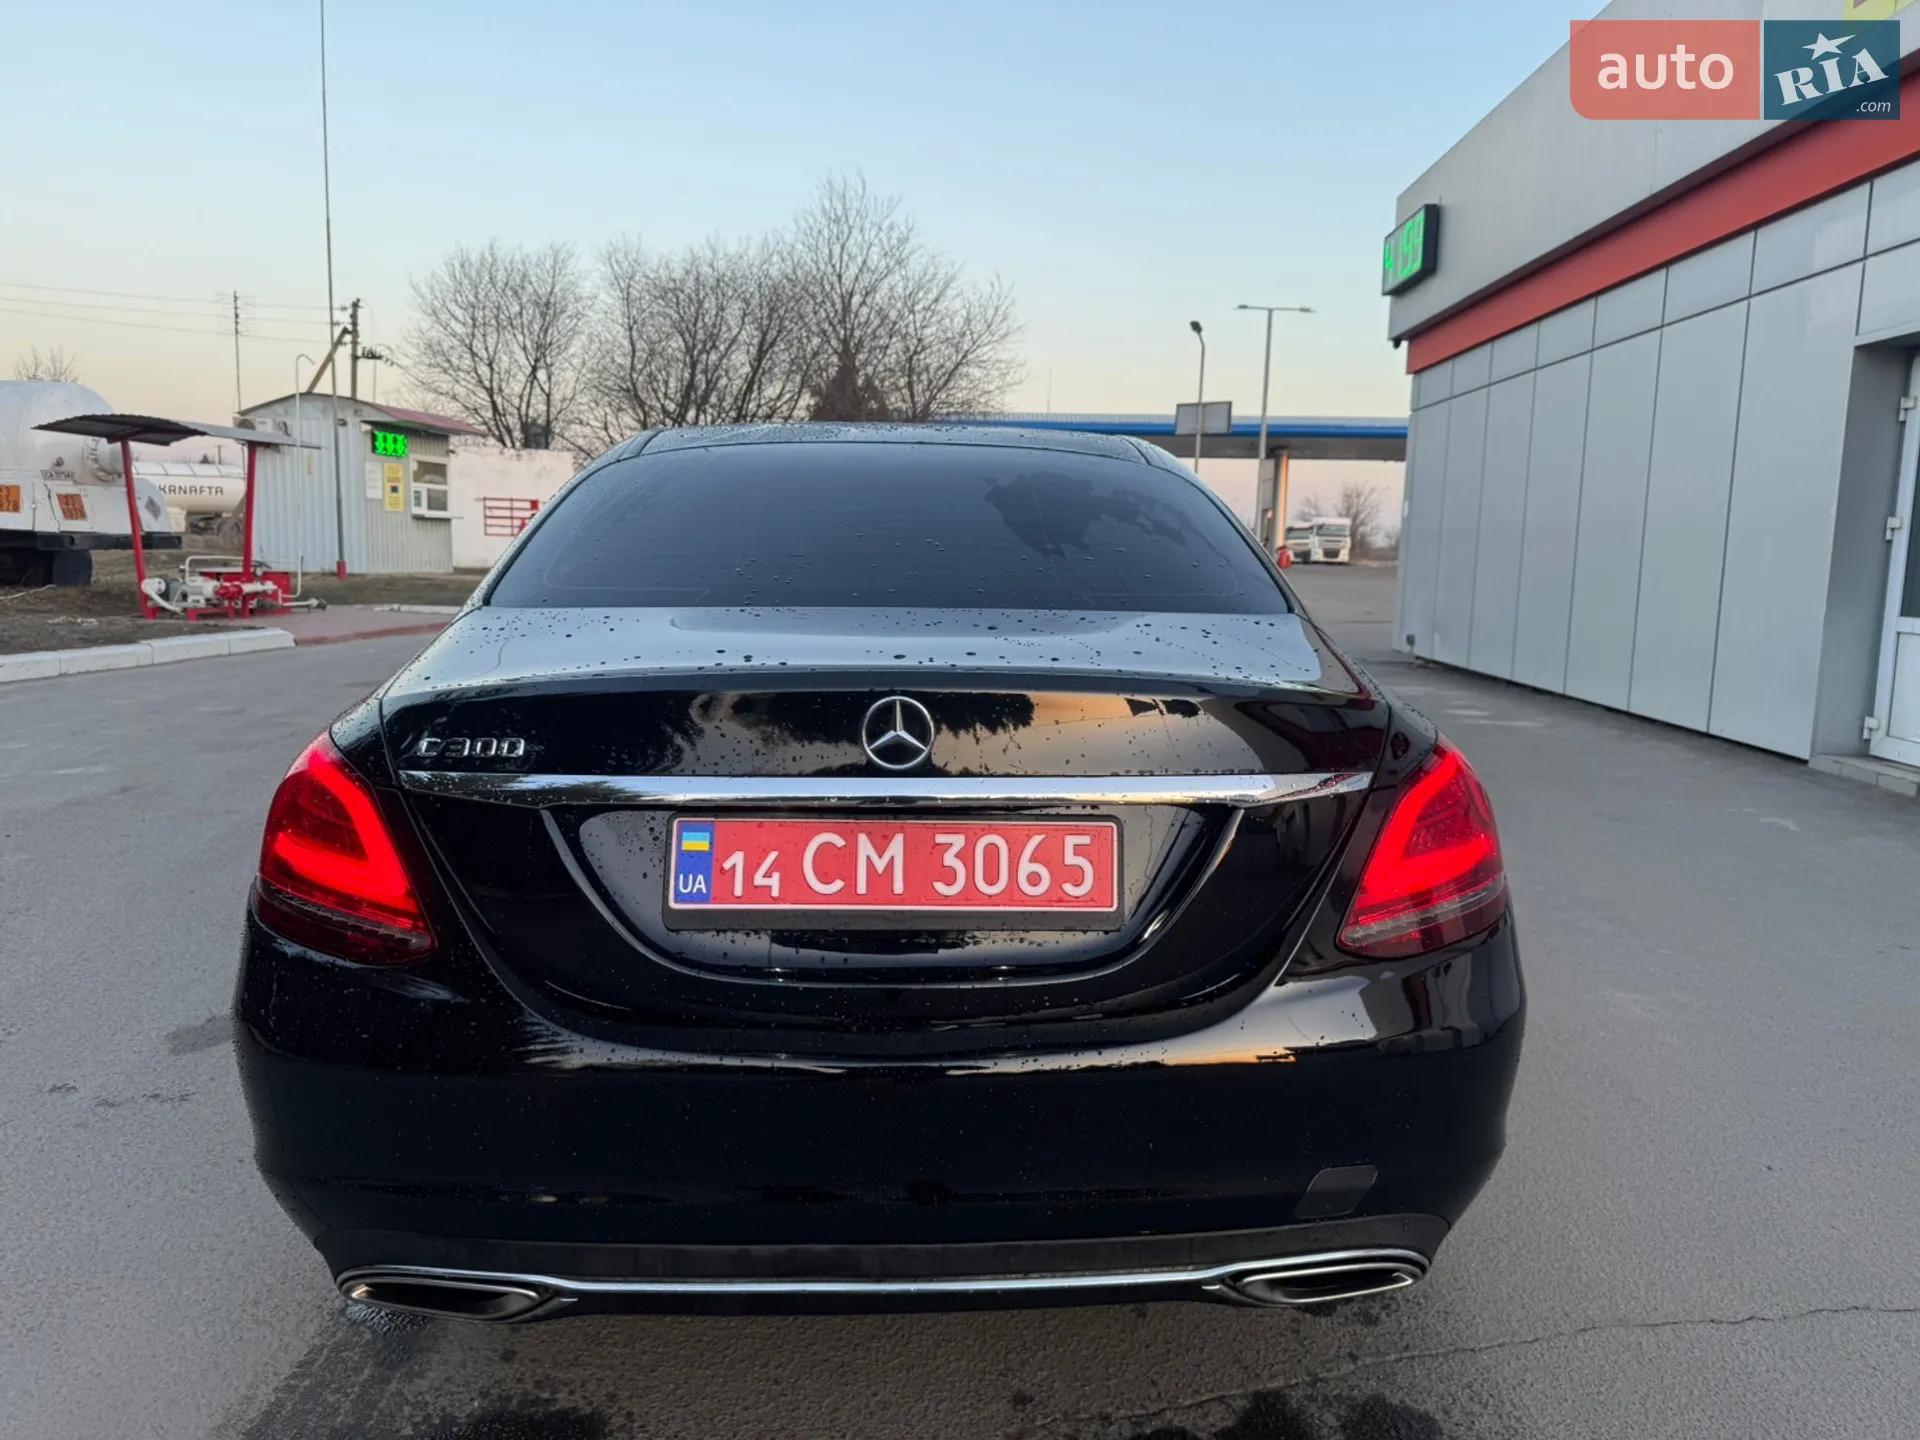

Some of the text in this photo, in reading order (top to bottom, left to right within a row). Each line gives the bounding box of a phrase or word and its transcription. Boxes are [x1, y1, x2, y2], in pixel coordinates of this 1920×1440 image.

[417, 737, 525, 758] C300
[722, 831, 1096, 898] 14 CM 3065
[678, 873, 707, 894] UA
